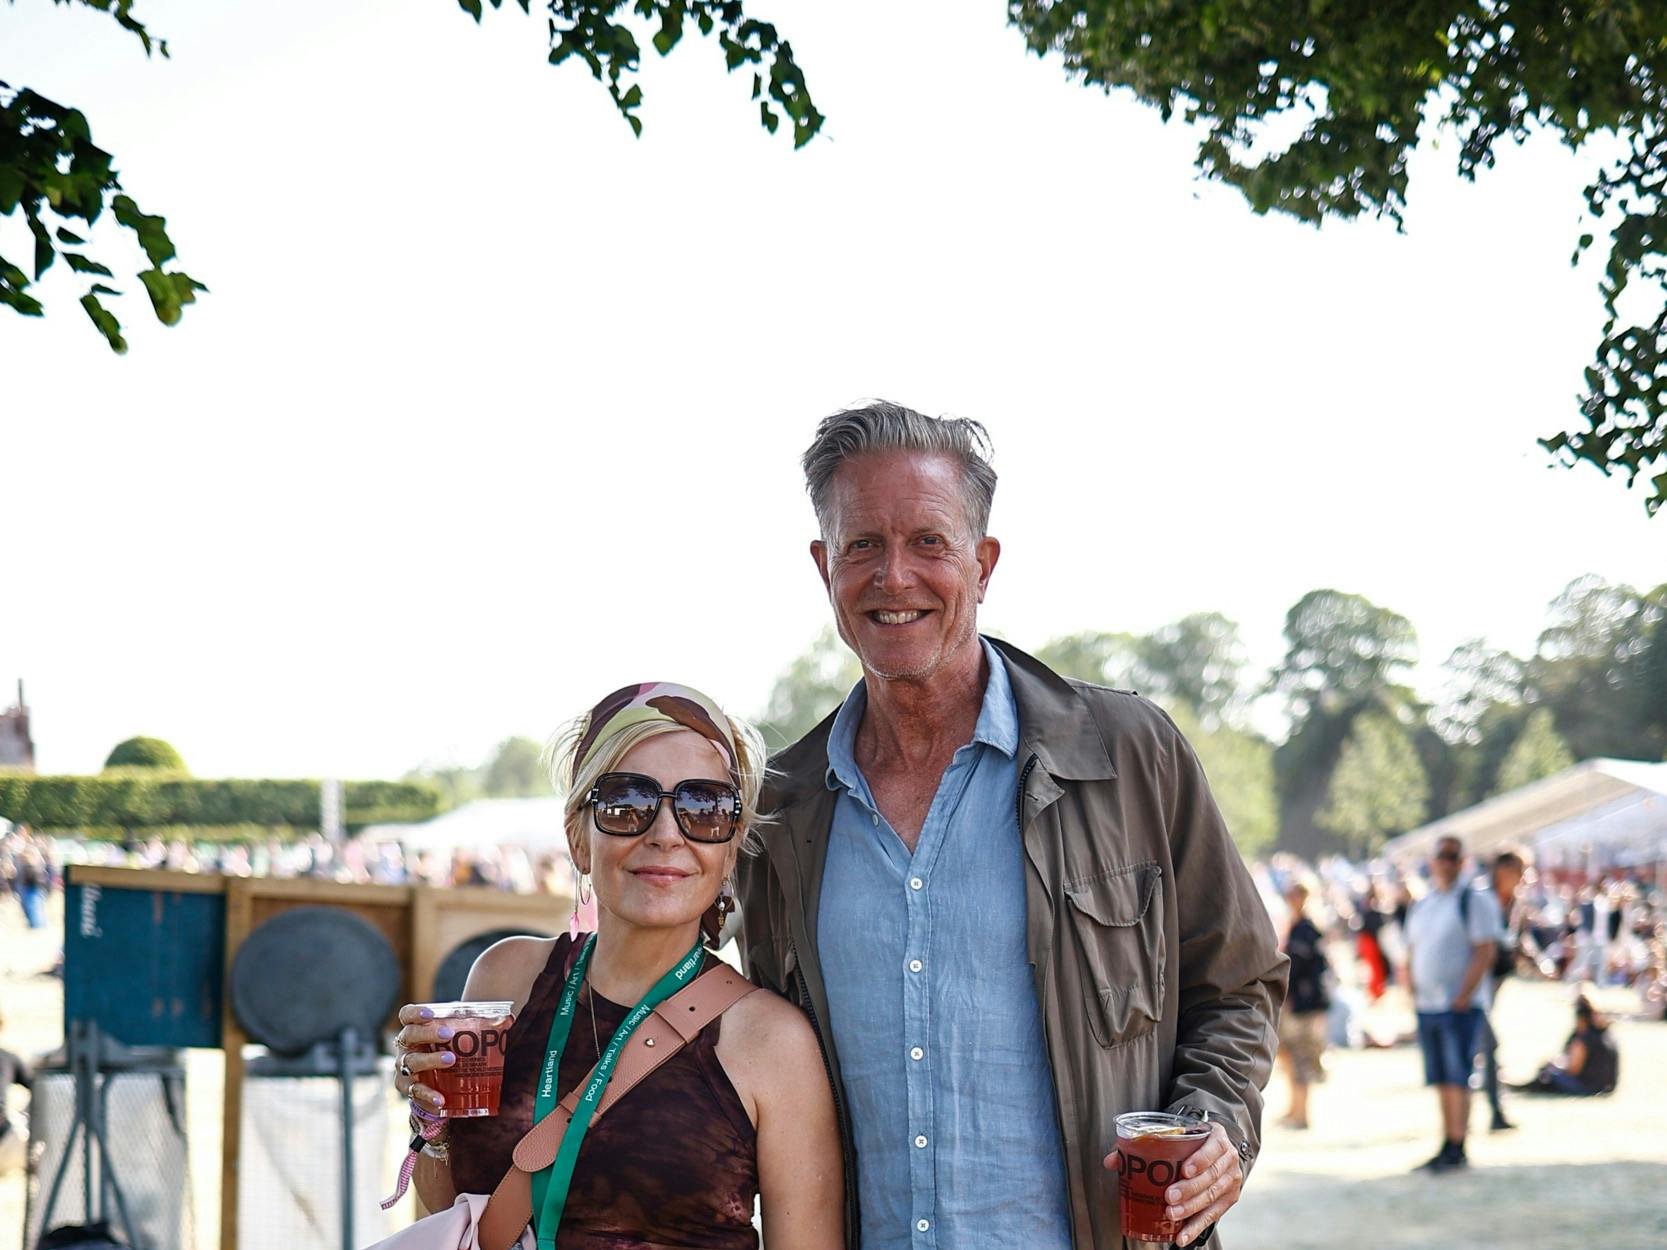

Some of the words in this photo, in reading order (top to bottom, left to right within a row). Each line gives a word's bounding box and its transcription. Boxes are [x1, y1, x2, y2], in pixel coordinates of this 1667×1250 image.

[675, 946, 703, 980] eartland
[560, 990, 575, 1016] Music
[629, 1004, 650, 1025] Music
[616, 1029, 628, 1041] Art
[600, 1047, 617, 1070] Talks
[541, 1050, 557, 1097] Heartland
[585, 1078, 603, 1102] Food
